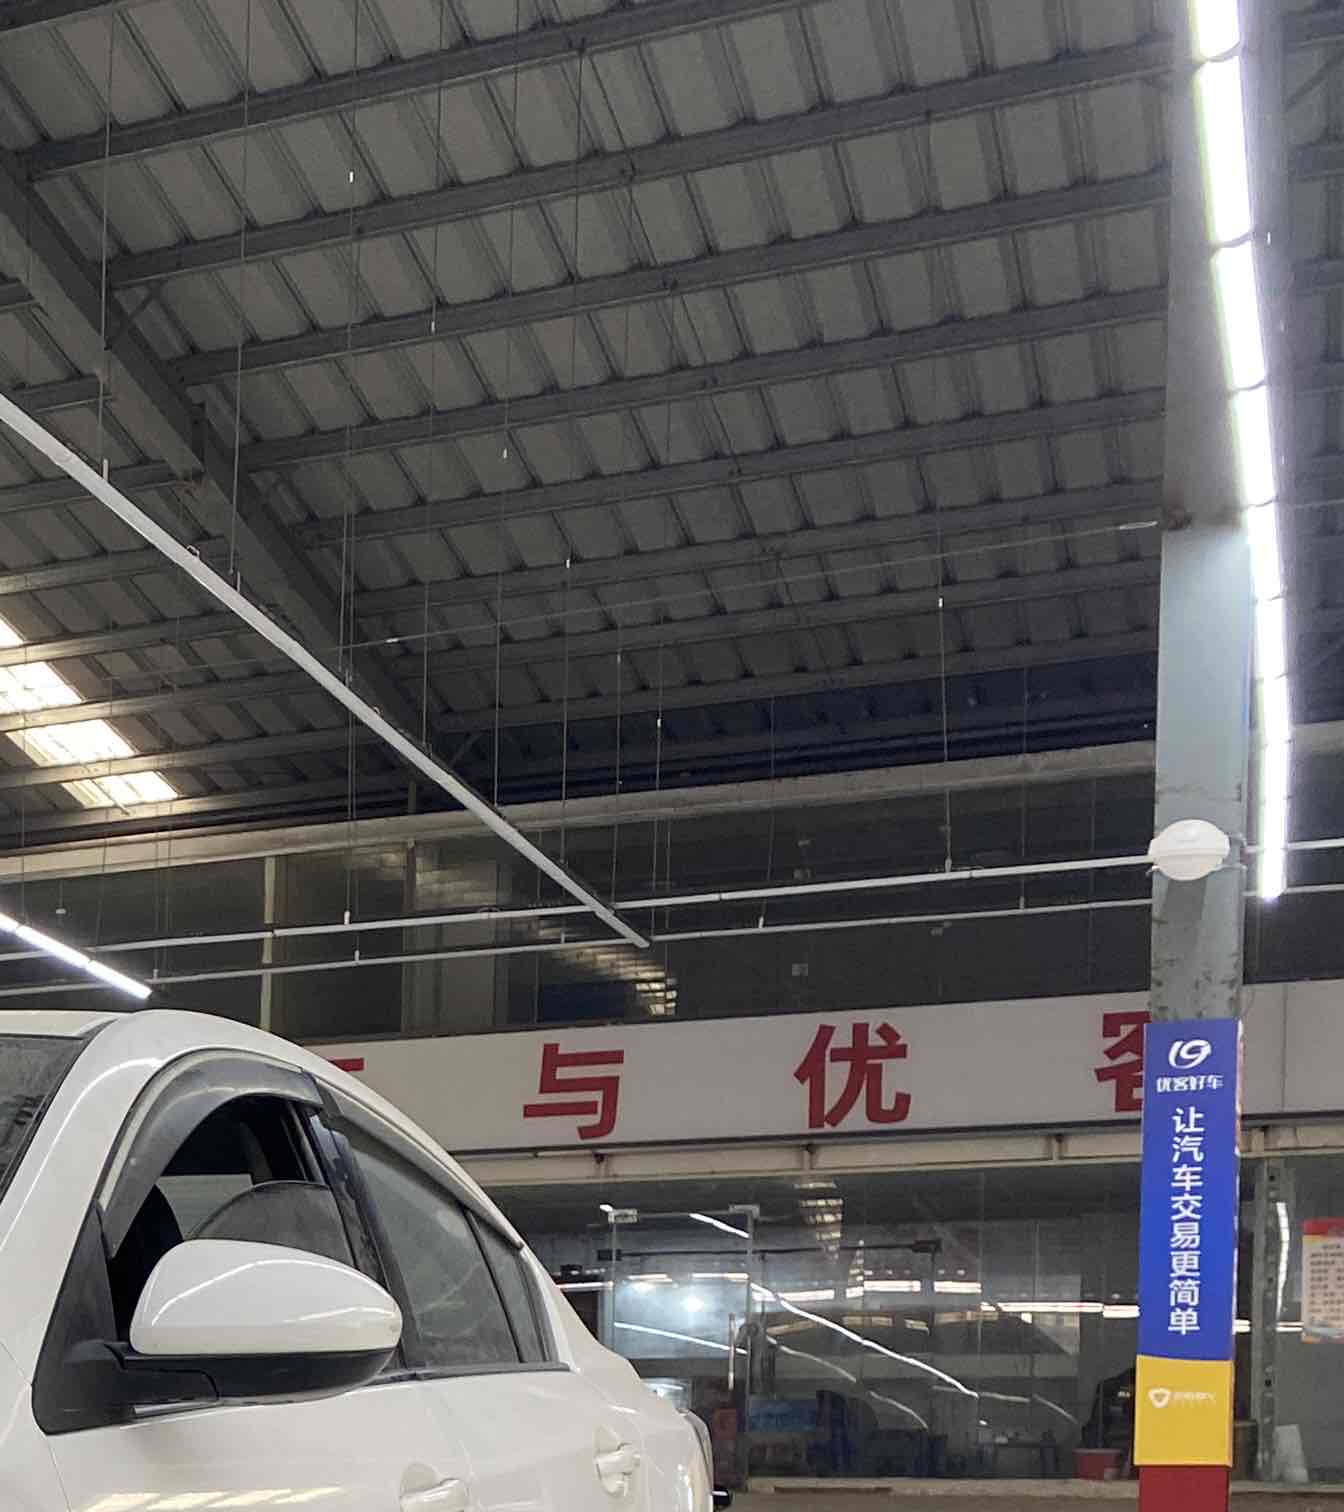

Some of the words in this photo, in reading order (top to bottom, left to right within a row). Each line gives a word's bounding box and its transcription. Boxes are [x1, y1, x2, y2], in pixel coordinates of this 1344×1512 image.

[1167, 1105, 1205, 1336] 让汽车交易更简单
